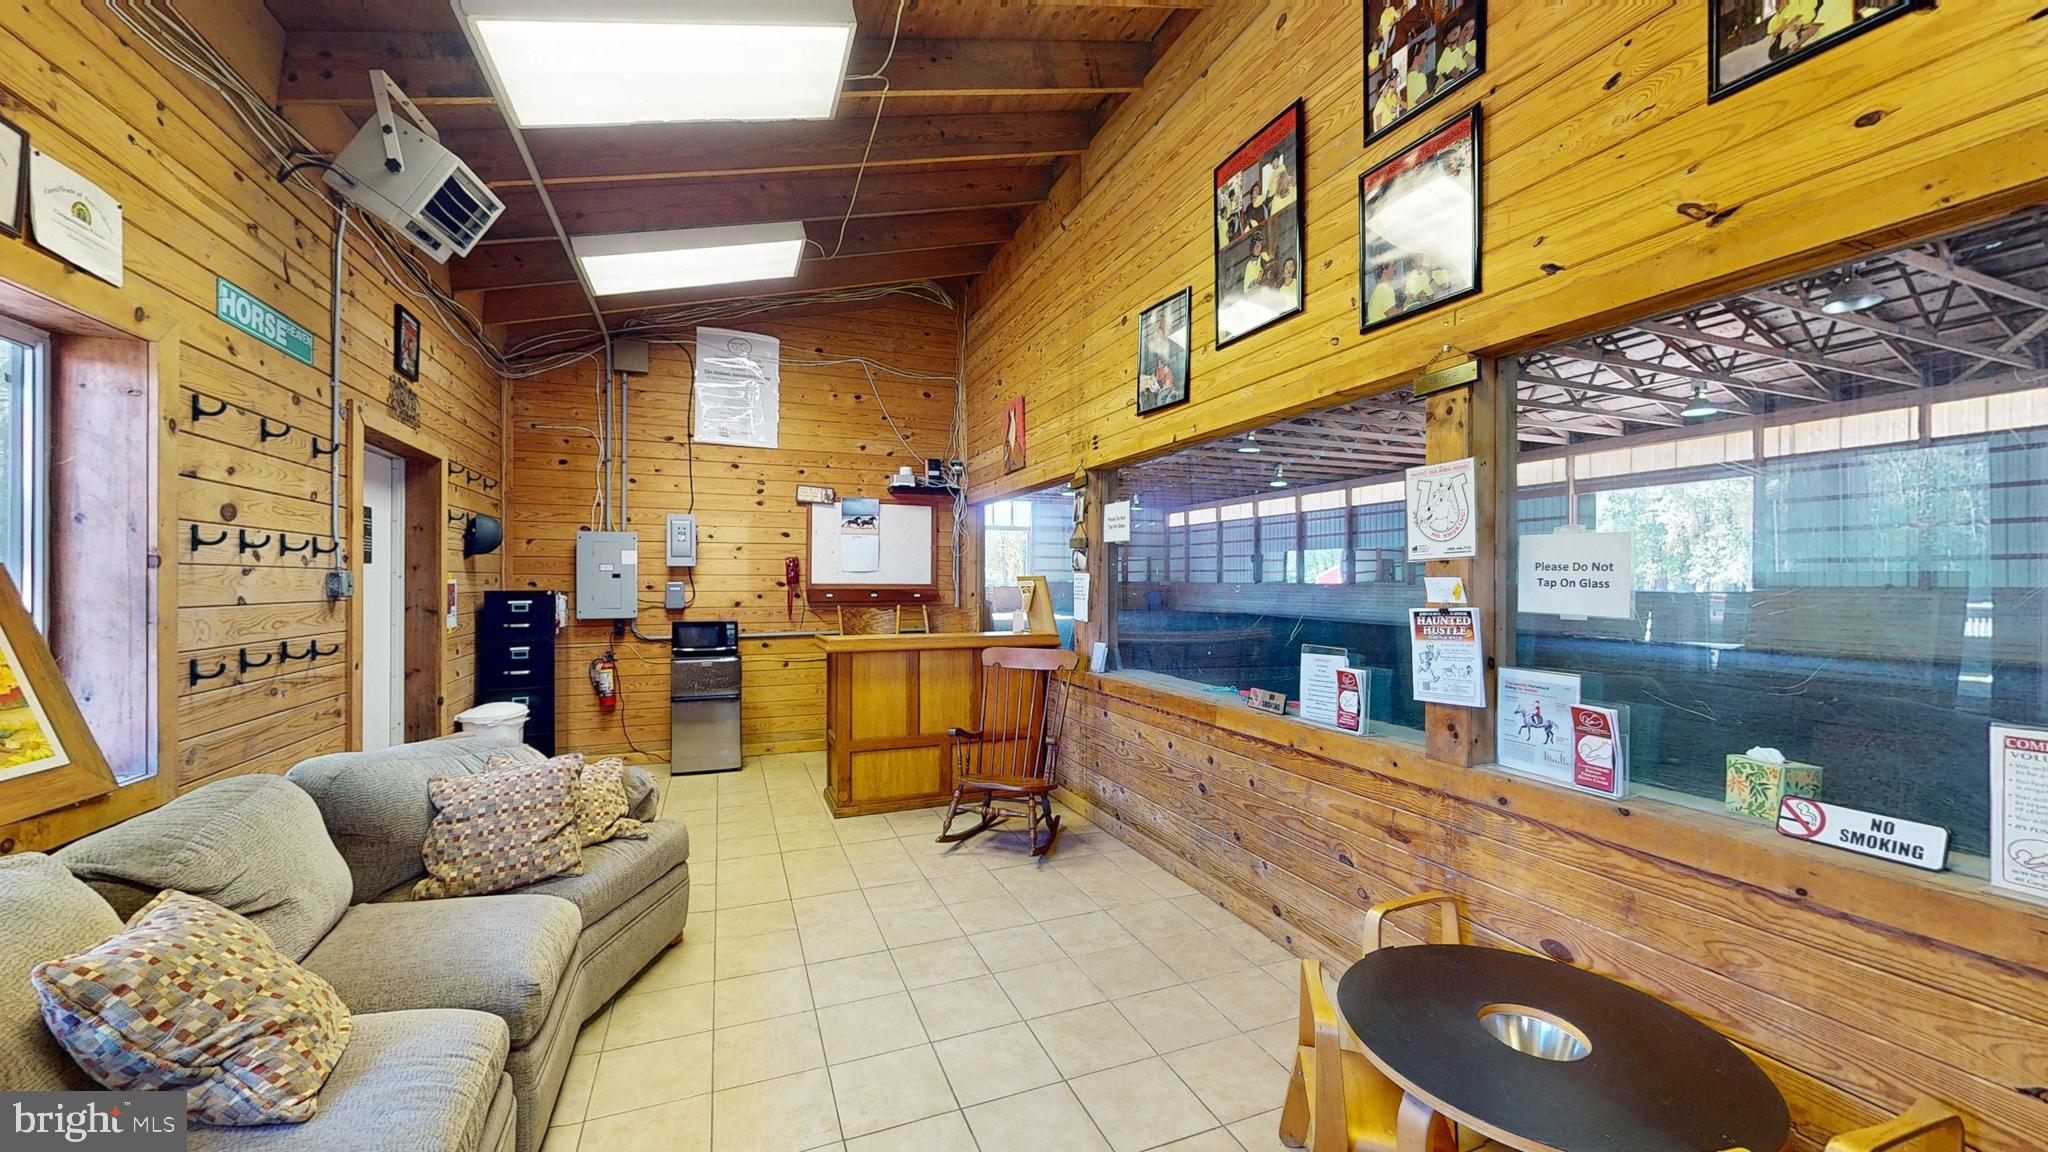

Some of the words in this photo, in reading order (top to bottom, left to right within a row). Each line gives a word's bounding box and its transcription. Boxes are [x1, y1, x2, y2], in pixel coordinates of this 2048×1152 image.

[220, 286, 288, 346] HORSE
[1534, 562, 1570, 571] Please
[1572, 562, 1589, 572] Do
[1591, 562, 1614, 572] Not
[1536, 577, 1557, 589] Tap
[1560, 578, 1576, 588] On
[1579, 578, 1610, 589] Glass
[1416, 616, 1471, 626] HAUNTED
[1422, 625, 1467, 635] HUSTLE
[1870, 818, 1895, 835] NO
[1839, 829, 1925, 860] SMOKING
